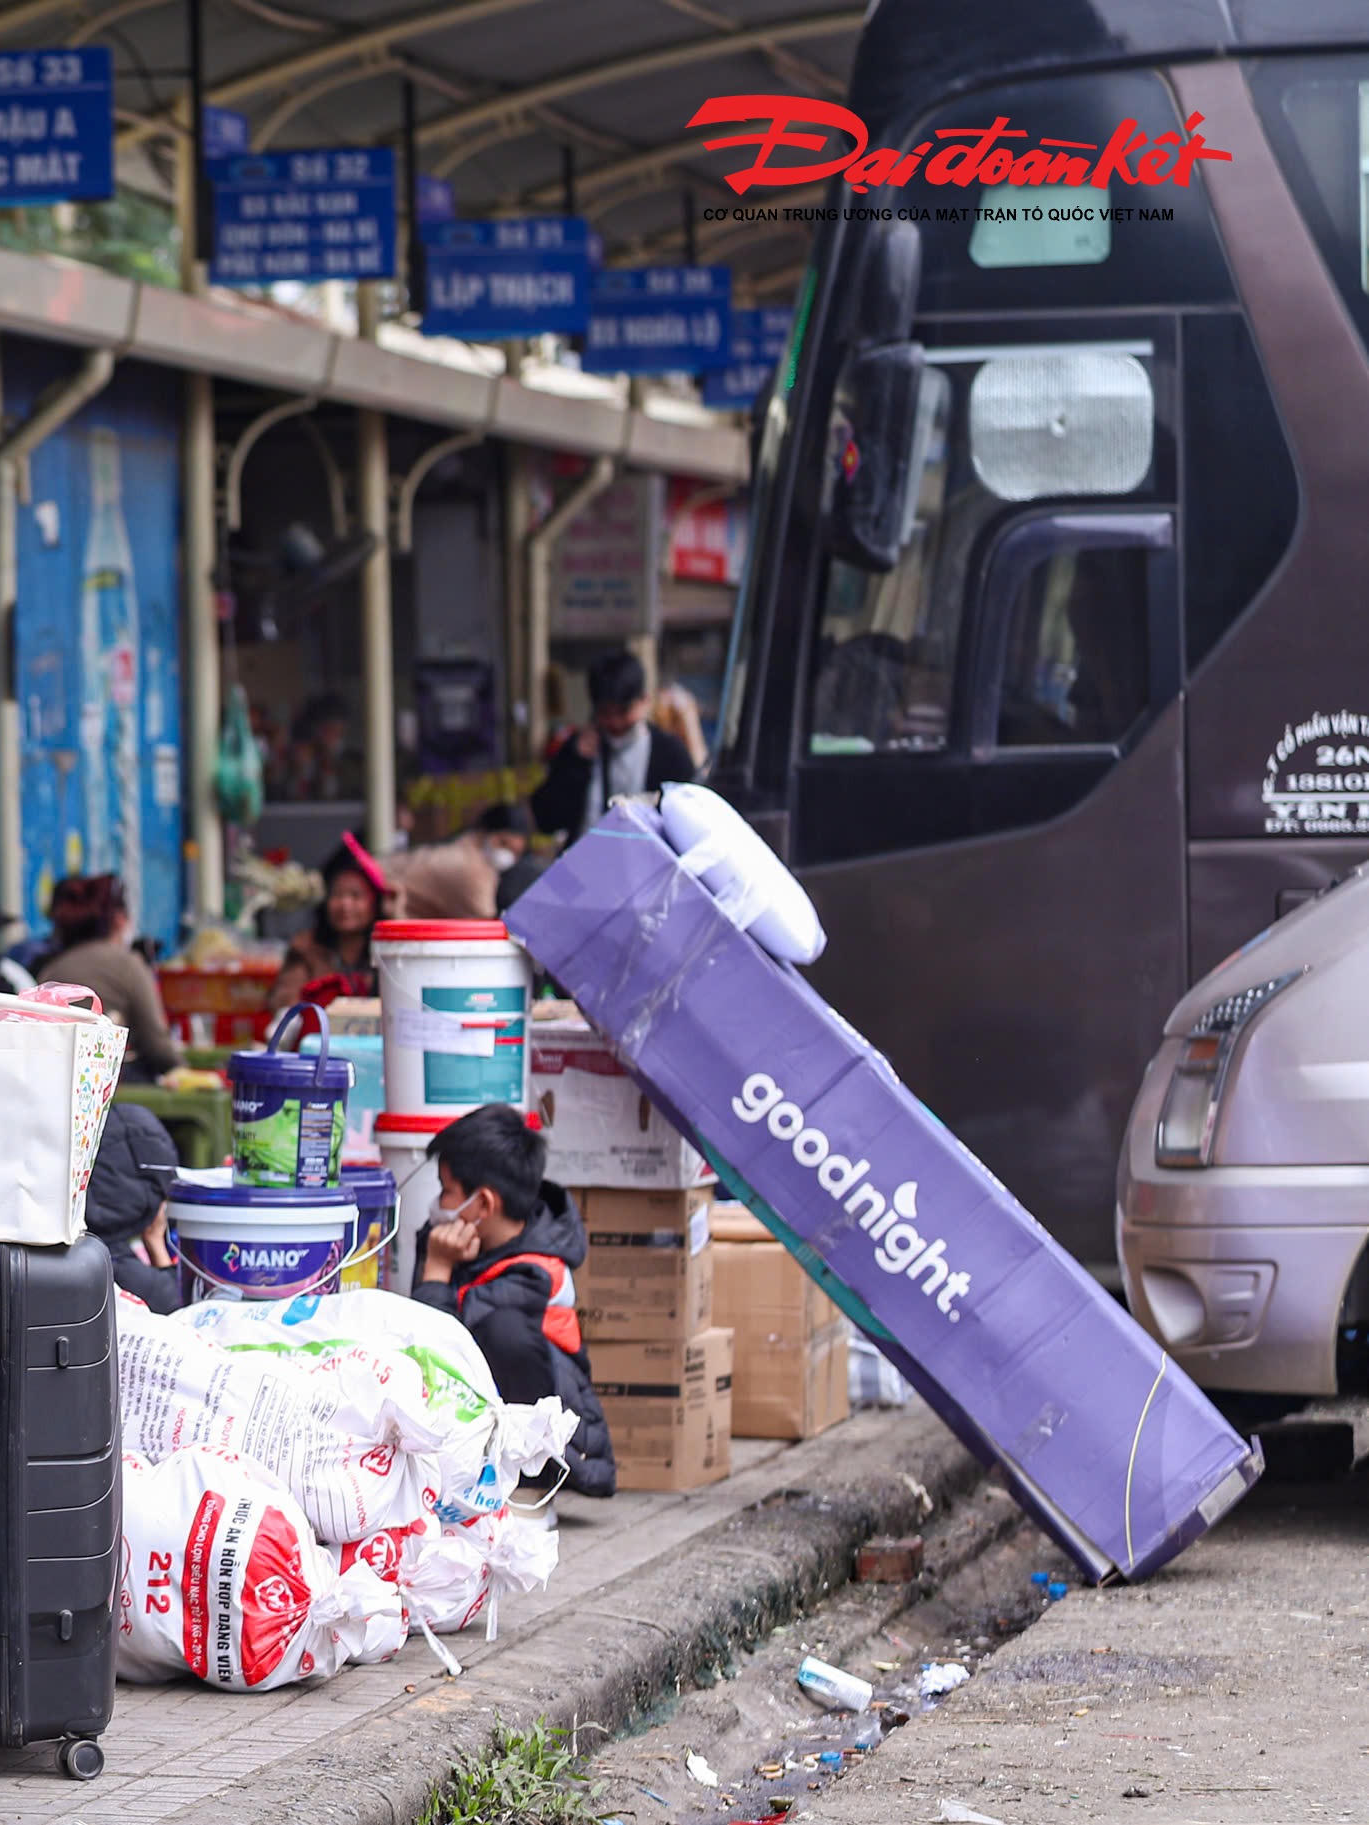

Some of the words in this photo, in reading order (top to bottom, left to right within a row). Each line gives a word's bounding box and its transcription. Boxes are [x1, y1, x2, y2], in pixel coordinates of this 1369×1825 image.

[41, 55, 84, 85] 33
[53, 106, 78, 138] A
[732, 1072, 971, 1315] goodnight
[195, 1525, 210, 1542] CHO
[146, 1550, 172, 1614] 212
[215, 1579, 233, 1611] HỢP
